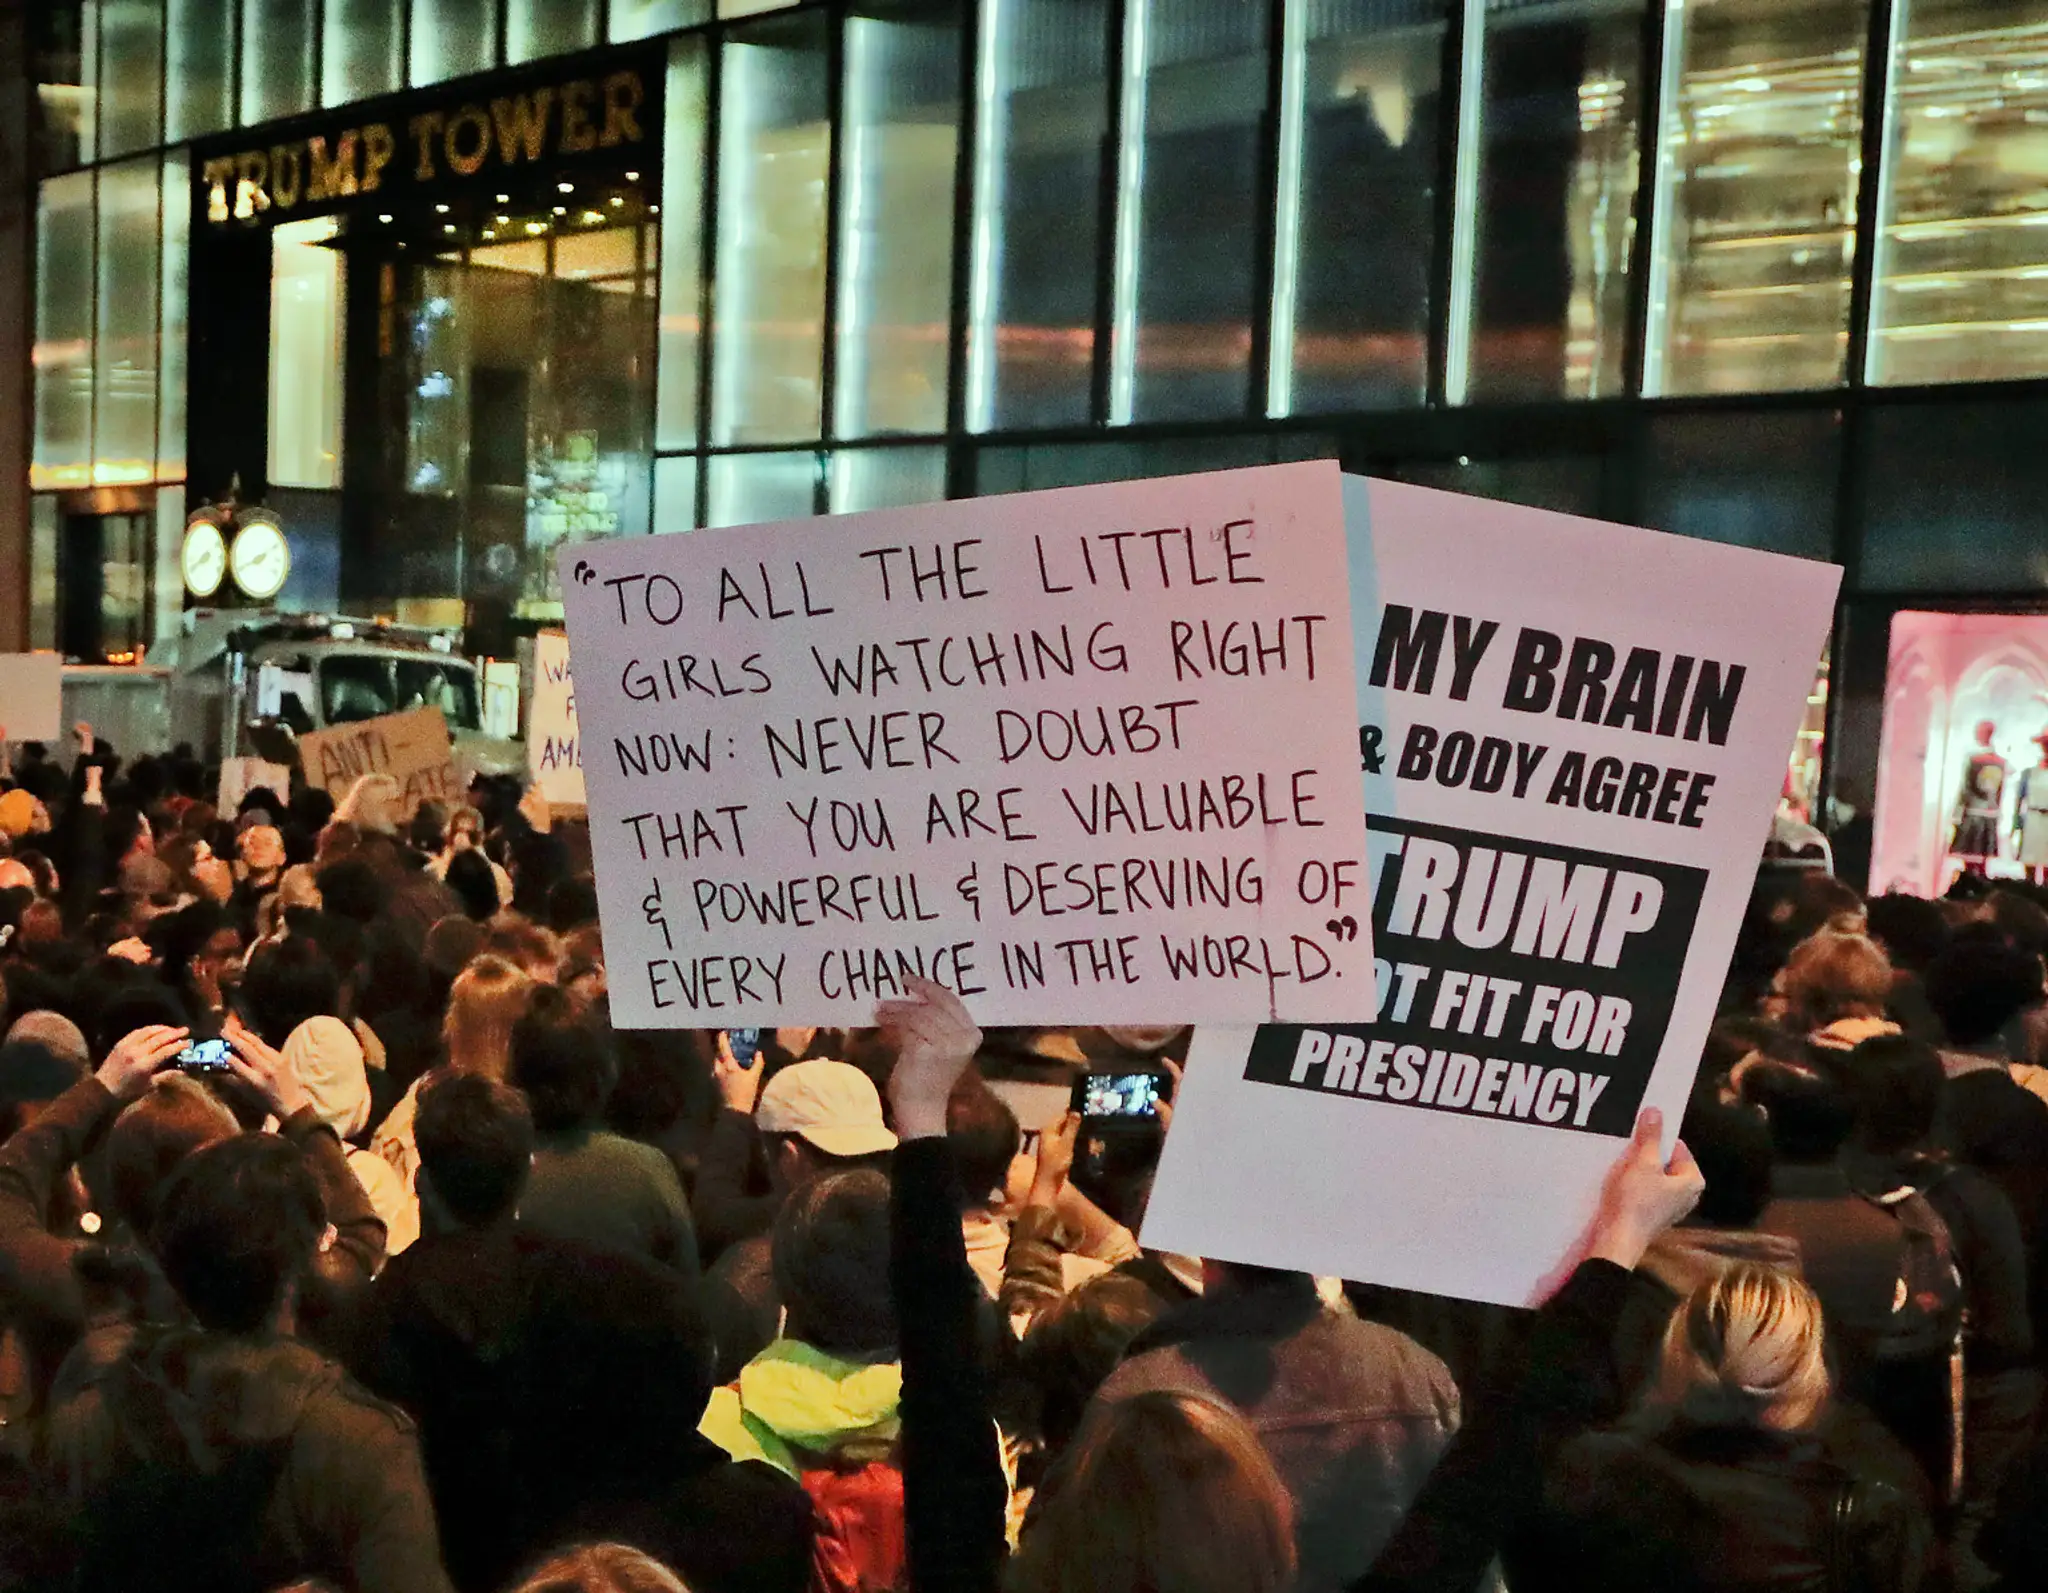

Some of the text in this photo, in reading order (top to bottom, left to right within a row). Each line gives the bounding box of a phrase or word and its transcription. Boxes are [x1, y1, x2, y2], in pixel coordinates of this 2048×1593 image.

[203, 70, 644, 222] TRUMP TOWER
[719, 562, 834, 622] ALL
[859, 541, 988, 602] THE
[1035, 520, 1265, 593] LITTLE
[622, 615, 1326, 702] GIRLS WATCHING RIGHT
[1369, 603, 1747, 746] MY BRAIN
[764, 711, 960, 778] NEVER
[996, 700, 1199, 764] DOUBT
[1396, 724, 1549, 798] BODY
[1545, 751, 1716, 828] AGREE
[621, 770, 1324, 860] THAT YOU ARE VALUABLE
[642, 857, 1358, 950] & POWERFUL & DESERVING OF
[647, 953, 785, 1010] EVERY
[819, 941, 987, 1001] CHANCE
[1002, 941, 1045, 990] IN
[1055, 936, 1141, 986] THE
[1430, 970, 1521, 1038] FIT
[1521, 985, 1632, 1057] FOR
[1289, 1030, 1610, 1127] PRESIDENCY
